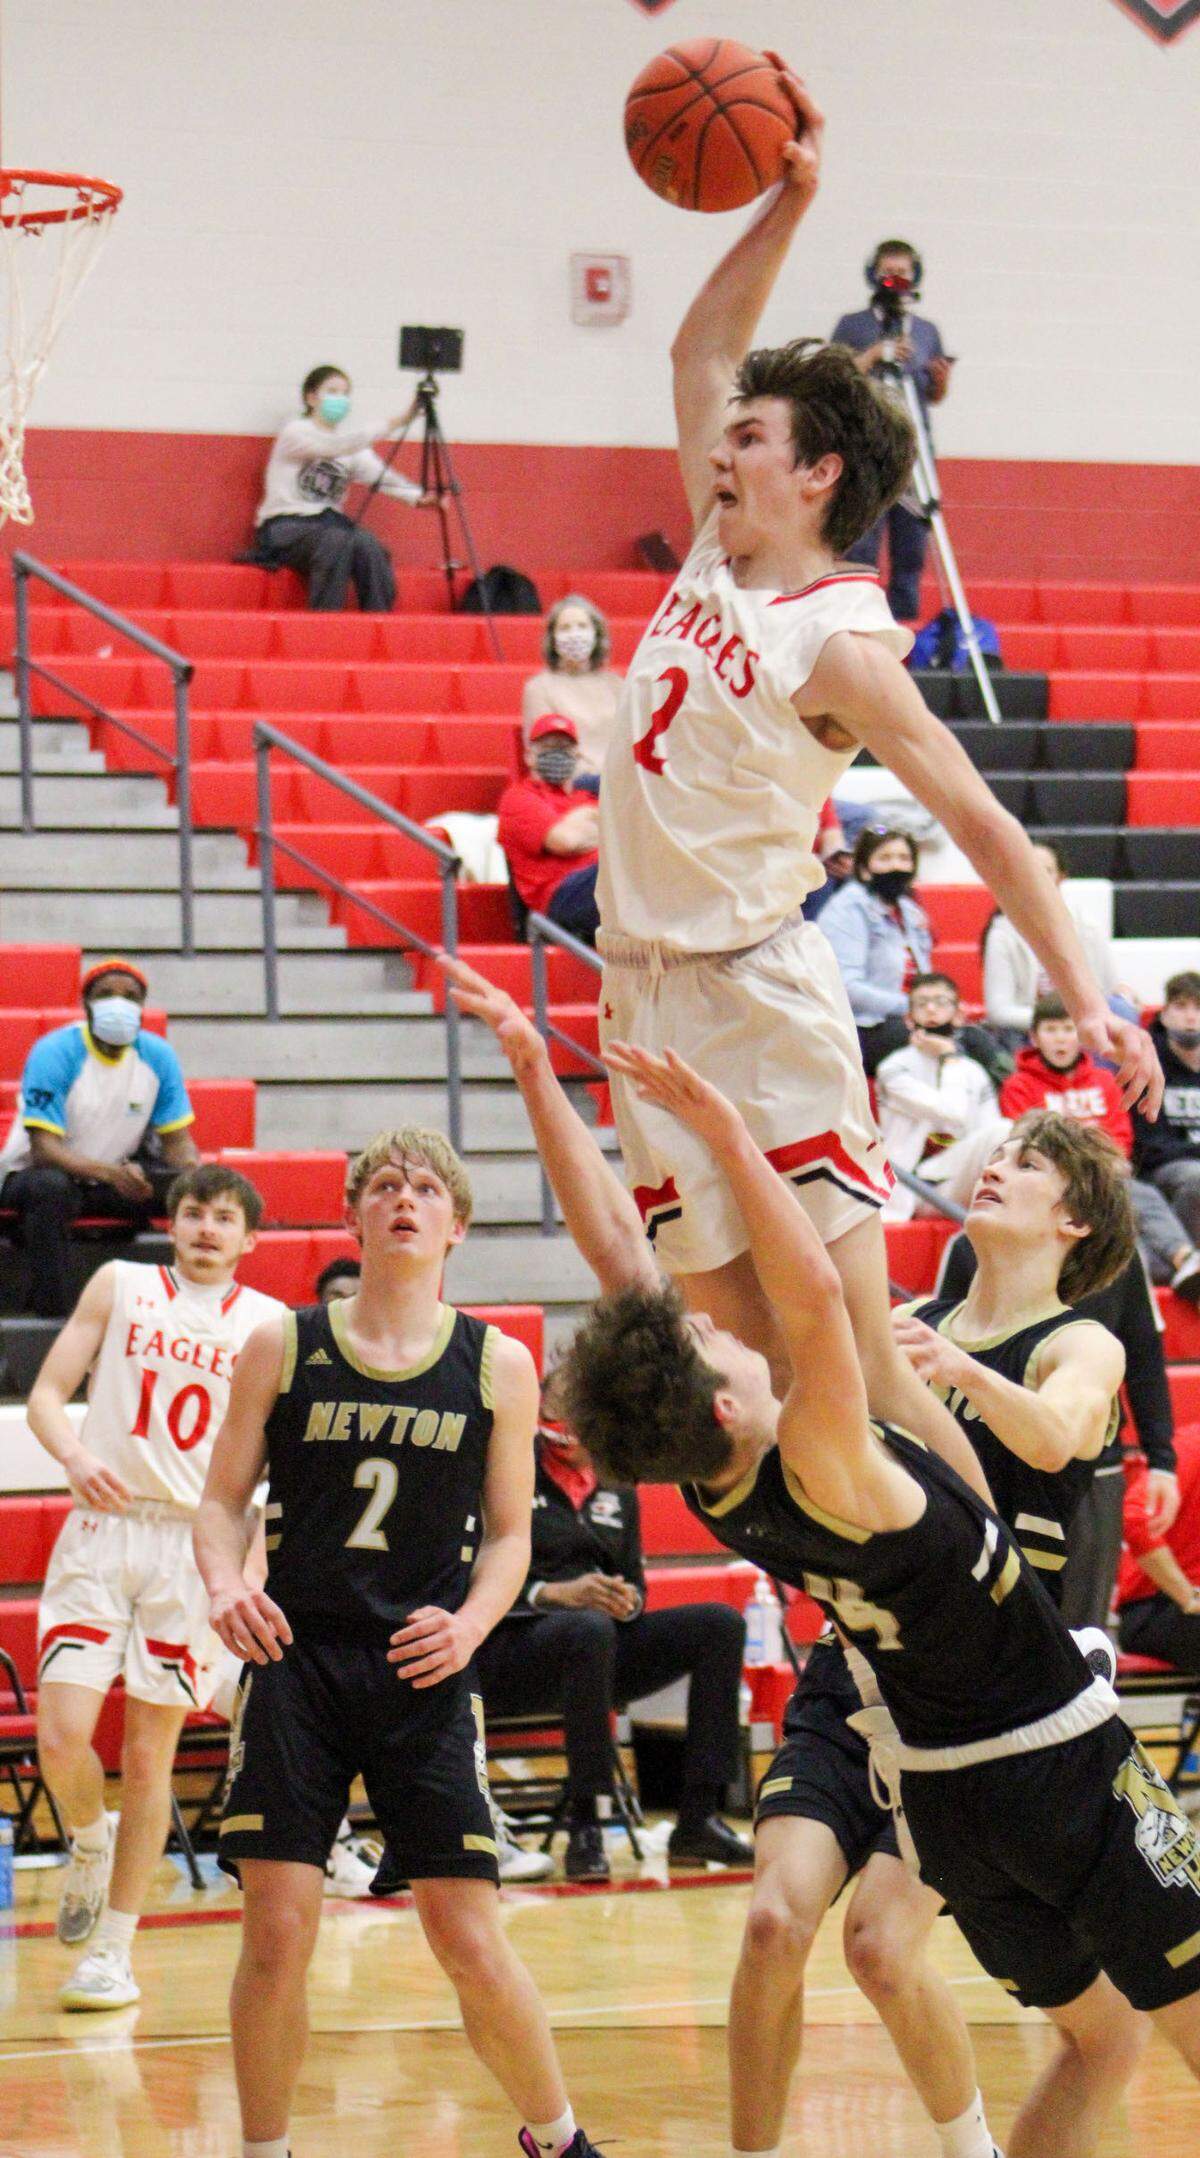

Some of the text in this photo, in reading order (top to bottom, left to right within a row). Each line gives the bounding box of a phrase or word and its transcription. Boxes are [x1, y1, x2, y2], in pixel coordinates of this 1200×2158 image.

[650, 591, 760, 698] EAGES
[632, 666, 689, 776] 2
[125, 1322, 239, 1384] EAGLE
[130, 1367, 212, 1452] 10
[303, 1401, 467, 1452] NEWTON
[344, 1457, 399, 1551] 2
